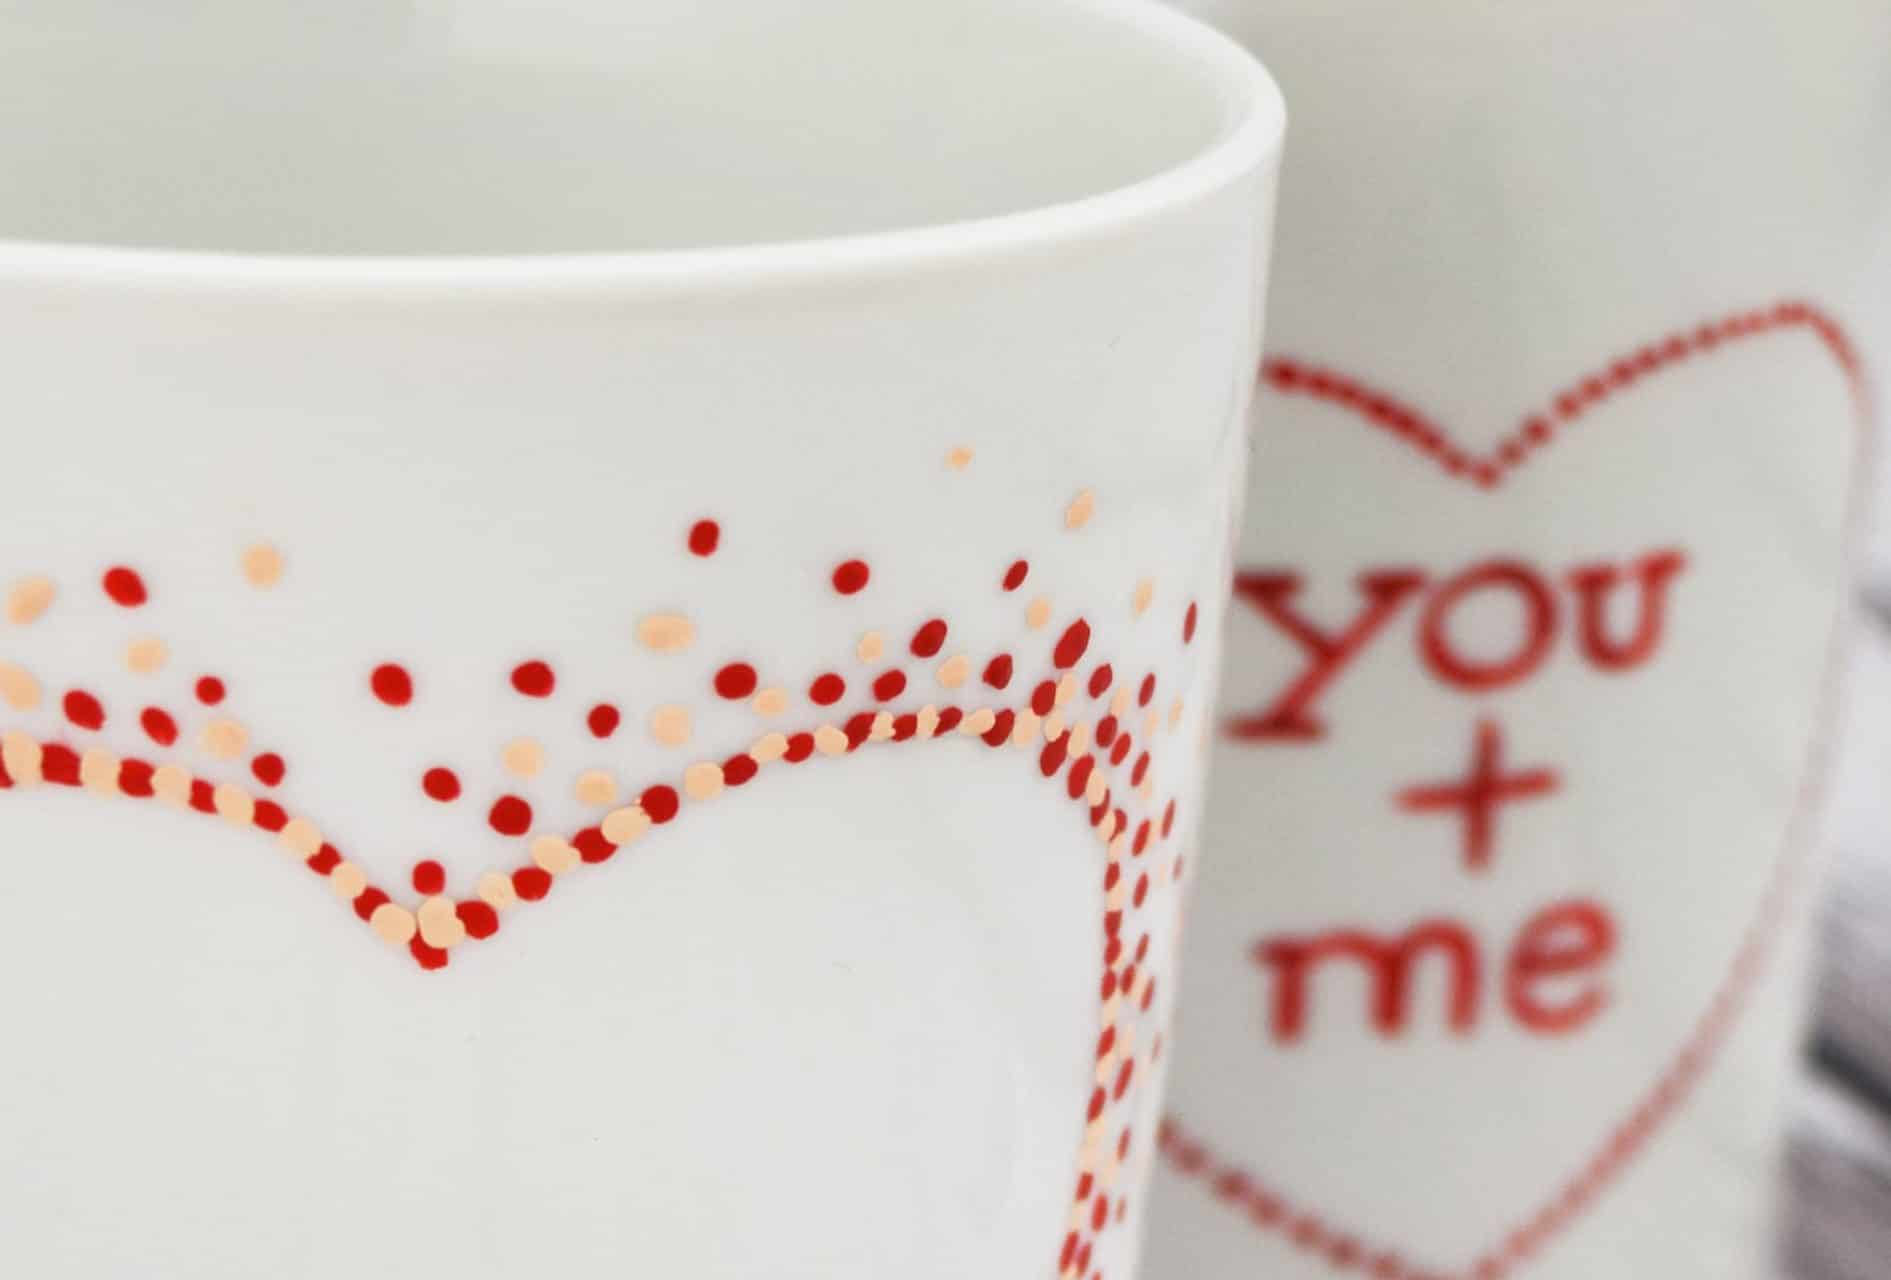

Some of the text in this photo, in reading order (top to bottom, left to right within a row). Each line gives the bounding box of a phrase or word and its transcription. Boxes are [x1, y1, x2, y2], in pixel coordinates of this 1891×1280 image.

[1223, 547, 1687, 744] you
[1393, 719, 1560, 872] +
[1254, 897, 1618, 1044] me
